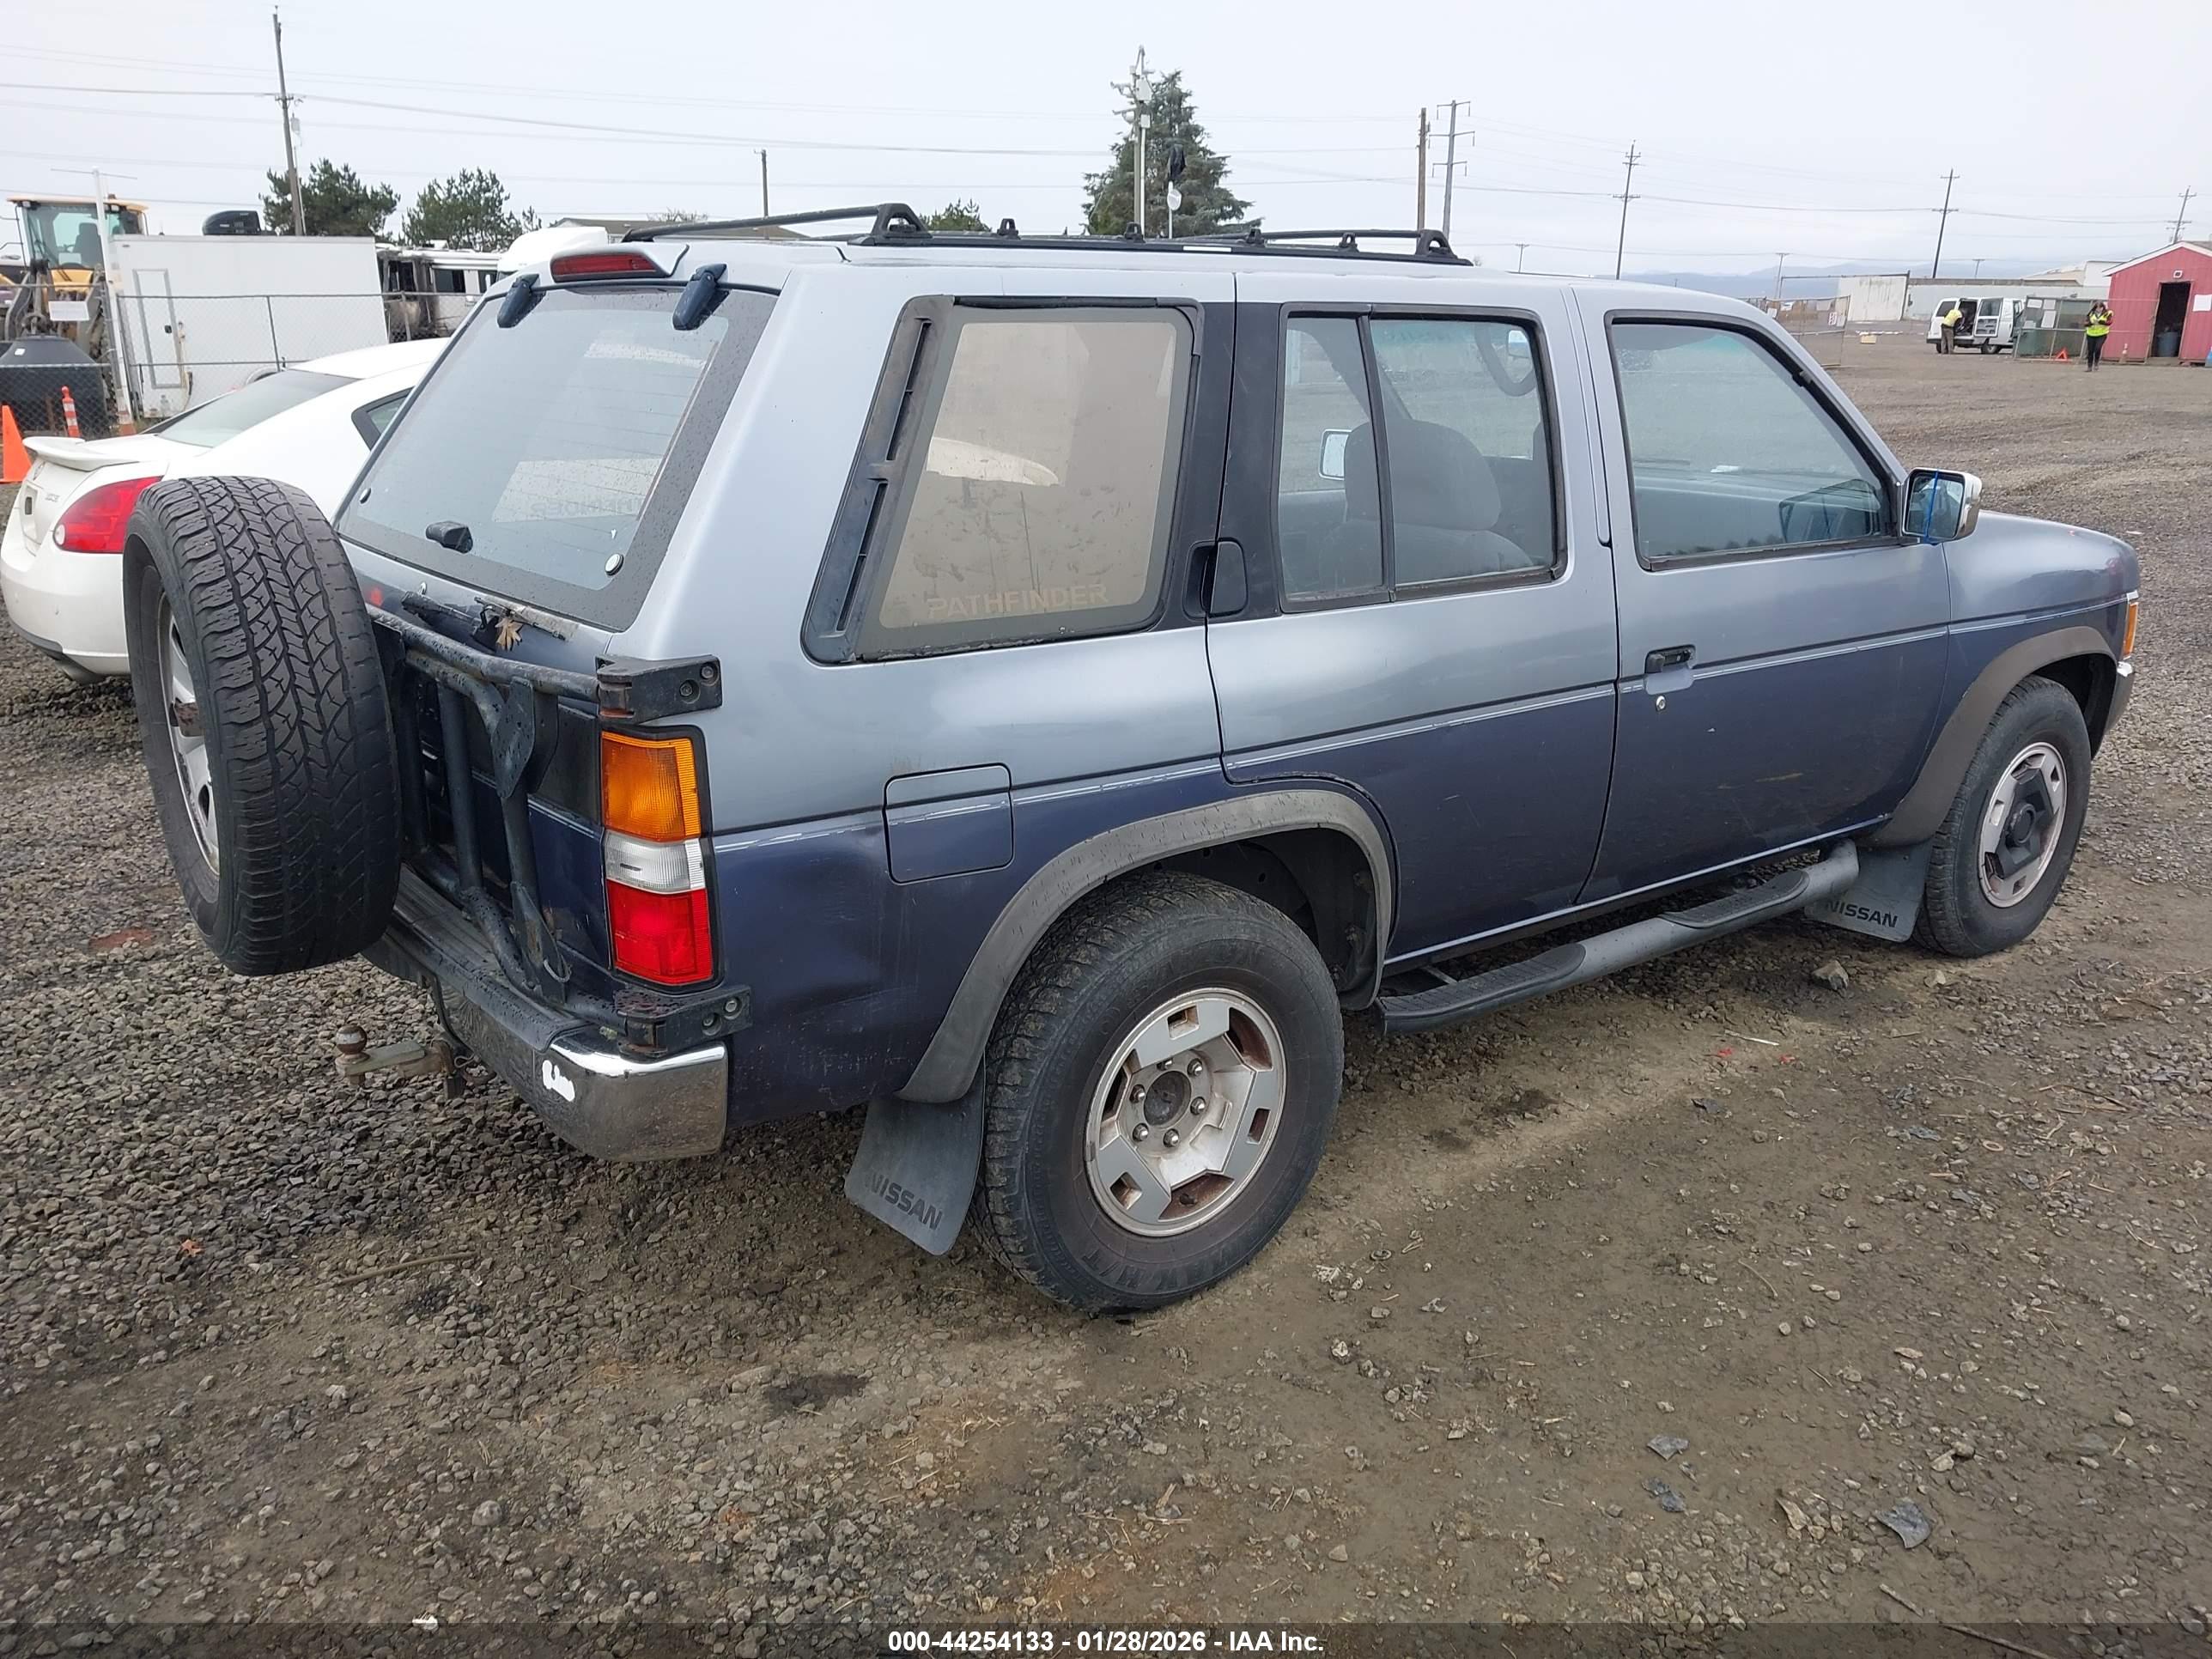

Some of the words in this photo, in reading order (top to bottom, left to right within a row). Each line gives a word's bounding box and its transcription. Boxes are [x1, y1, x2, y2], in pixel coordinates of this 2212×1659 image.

[927, 583, 1109, 618] PATHFINDER
[1826, 899, 1899, 928] NISSAN
[866, 1172, 944, 1231] NISSAN
